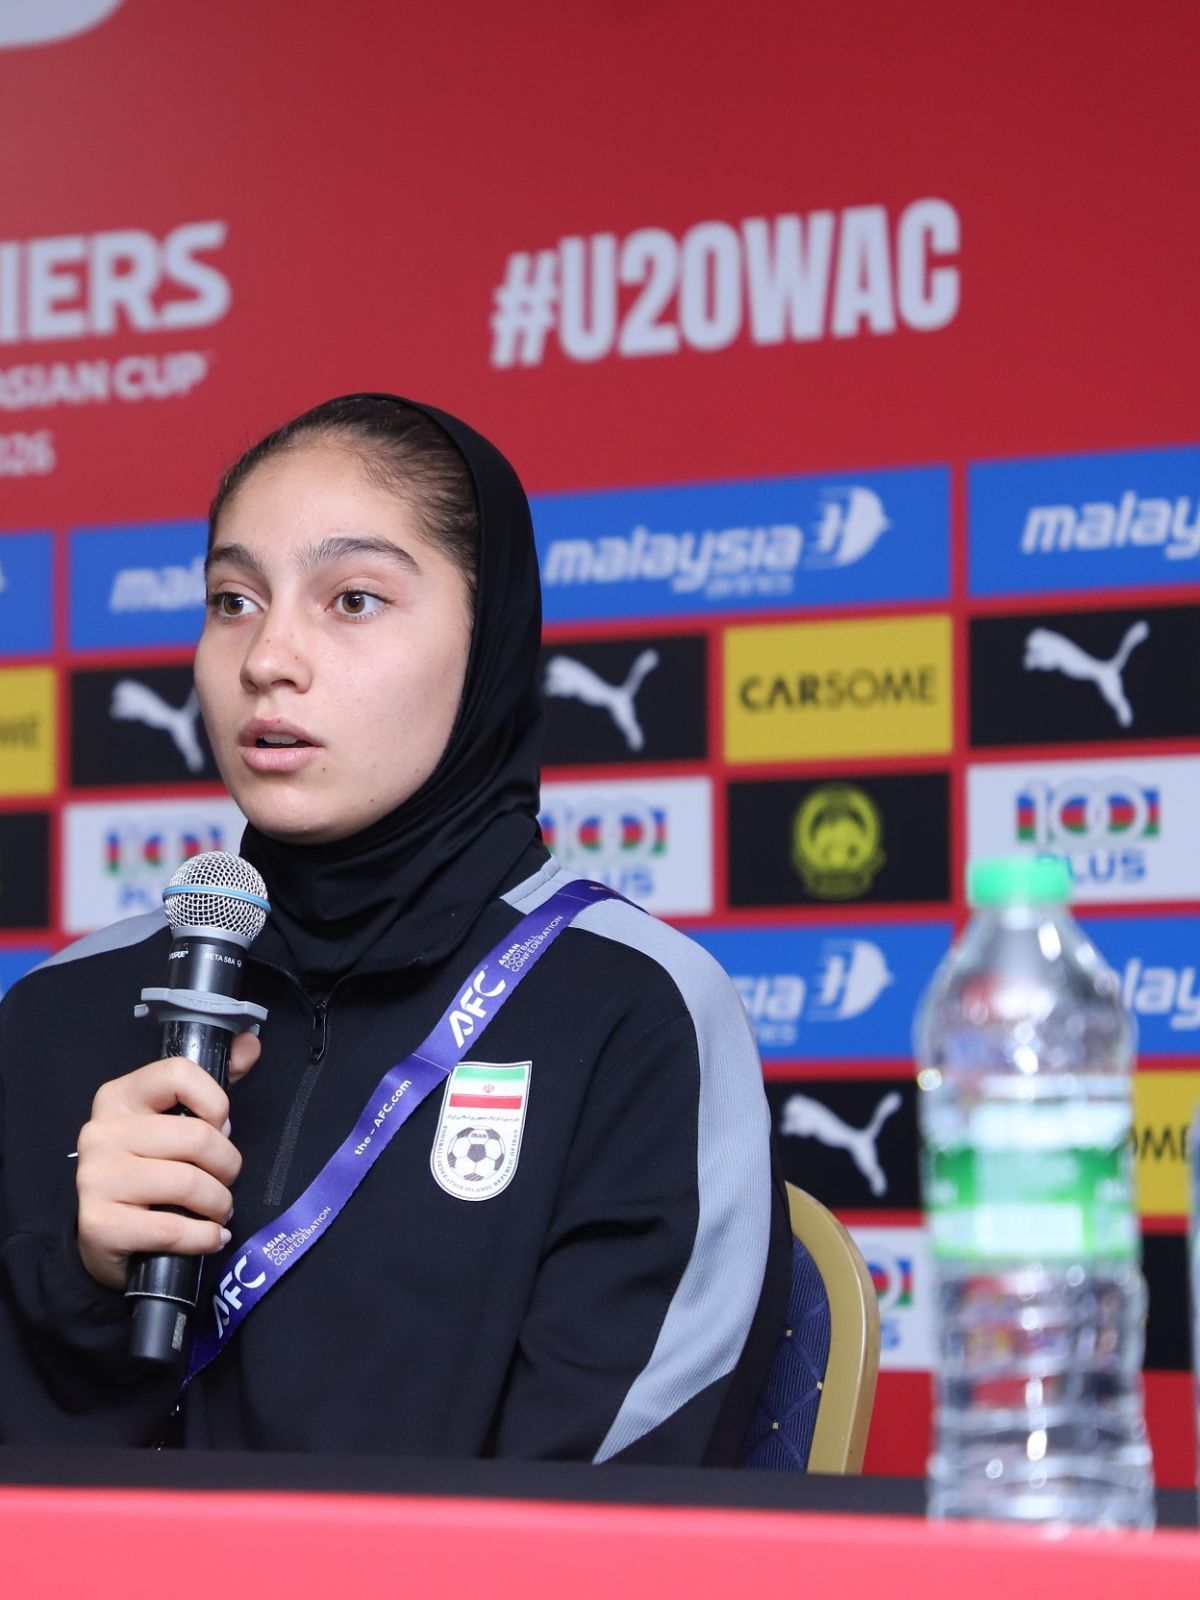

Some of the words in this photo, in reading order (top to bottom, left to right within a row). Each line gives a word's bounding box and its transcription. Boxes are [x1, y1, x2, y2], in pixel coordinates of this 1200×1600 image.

[490, 197, 961, 370] #U20WAC
[114, 350, 208, 401] CUP
[1021, 489, 1200, 561] malay
[544, 525, 804, 594] malaysia
[738, 664, 938, 714] CARSOME
[498, 943, 521, 967] ASIAN
[504, 934, 539, 970] FOOTBALL
[511, 915, 563, 972] CONFEDERATION
[449, 970, 507, 1049] AFC
[262, 1232, 286, 1255] ASIAN
[267, 1227, 306, 1262] FOOTBALL
[274, 1206, 332, 1266] CONFEDERATION
[212, 1254, 266, 1340] AFC
